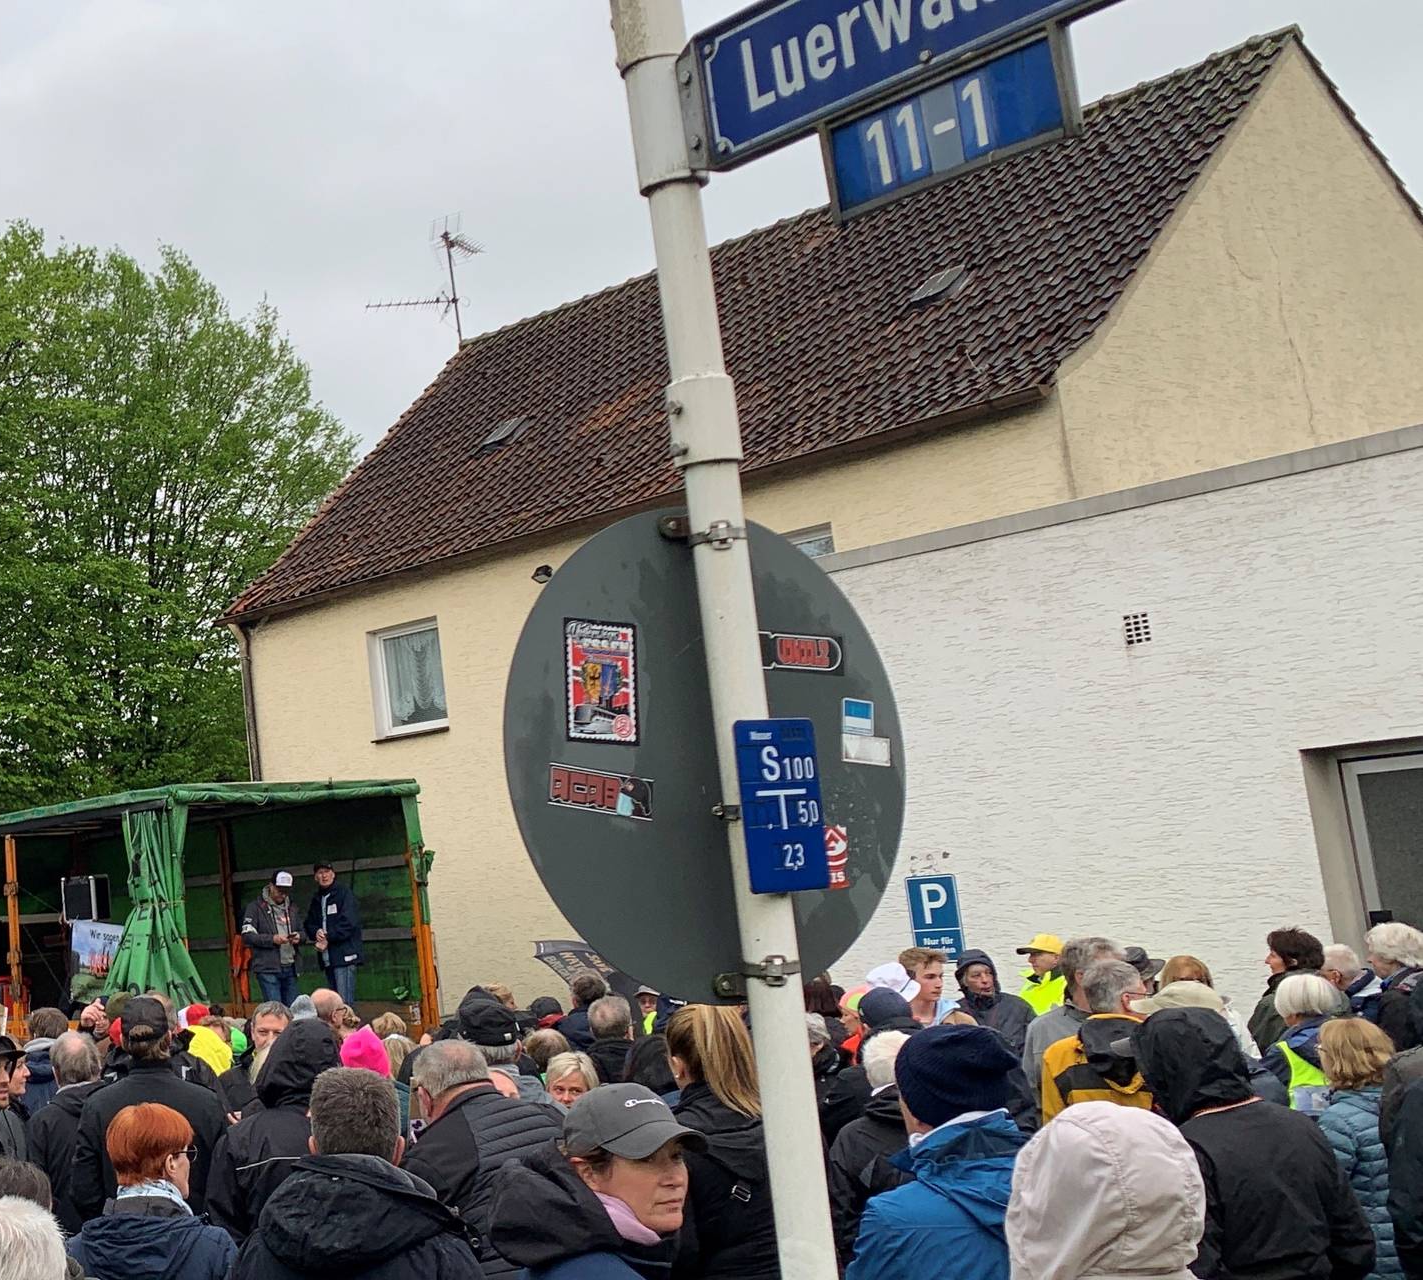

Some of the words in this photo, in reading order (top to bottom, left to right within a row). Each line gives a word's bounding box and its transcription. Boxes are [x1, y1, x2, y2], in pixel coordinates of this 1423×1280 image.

[741, 0, 997, 113] Luerwa
[866, 78, 990, 186] 11-1
[920, 883, 947, 924] P
[923, 937, 939, 945] Nur
